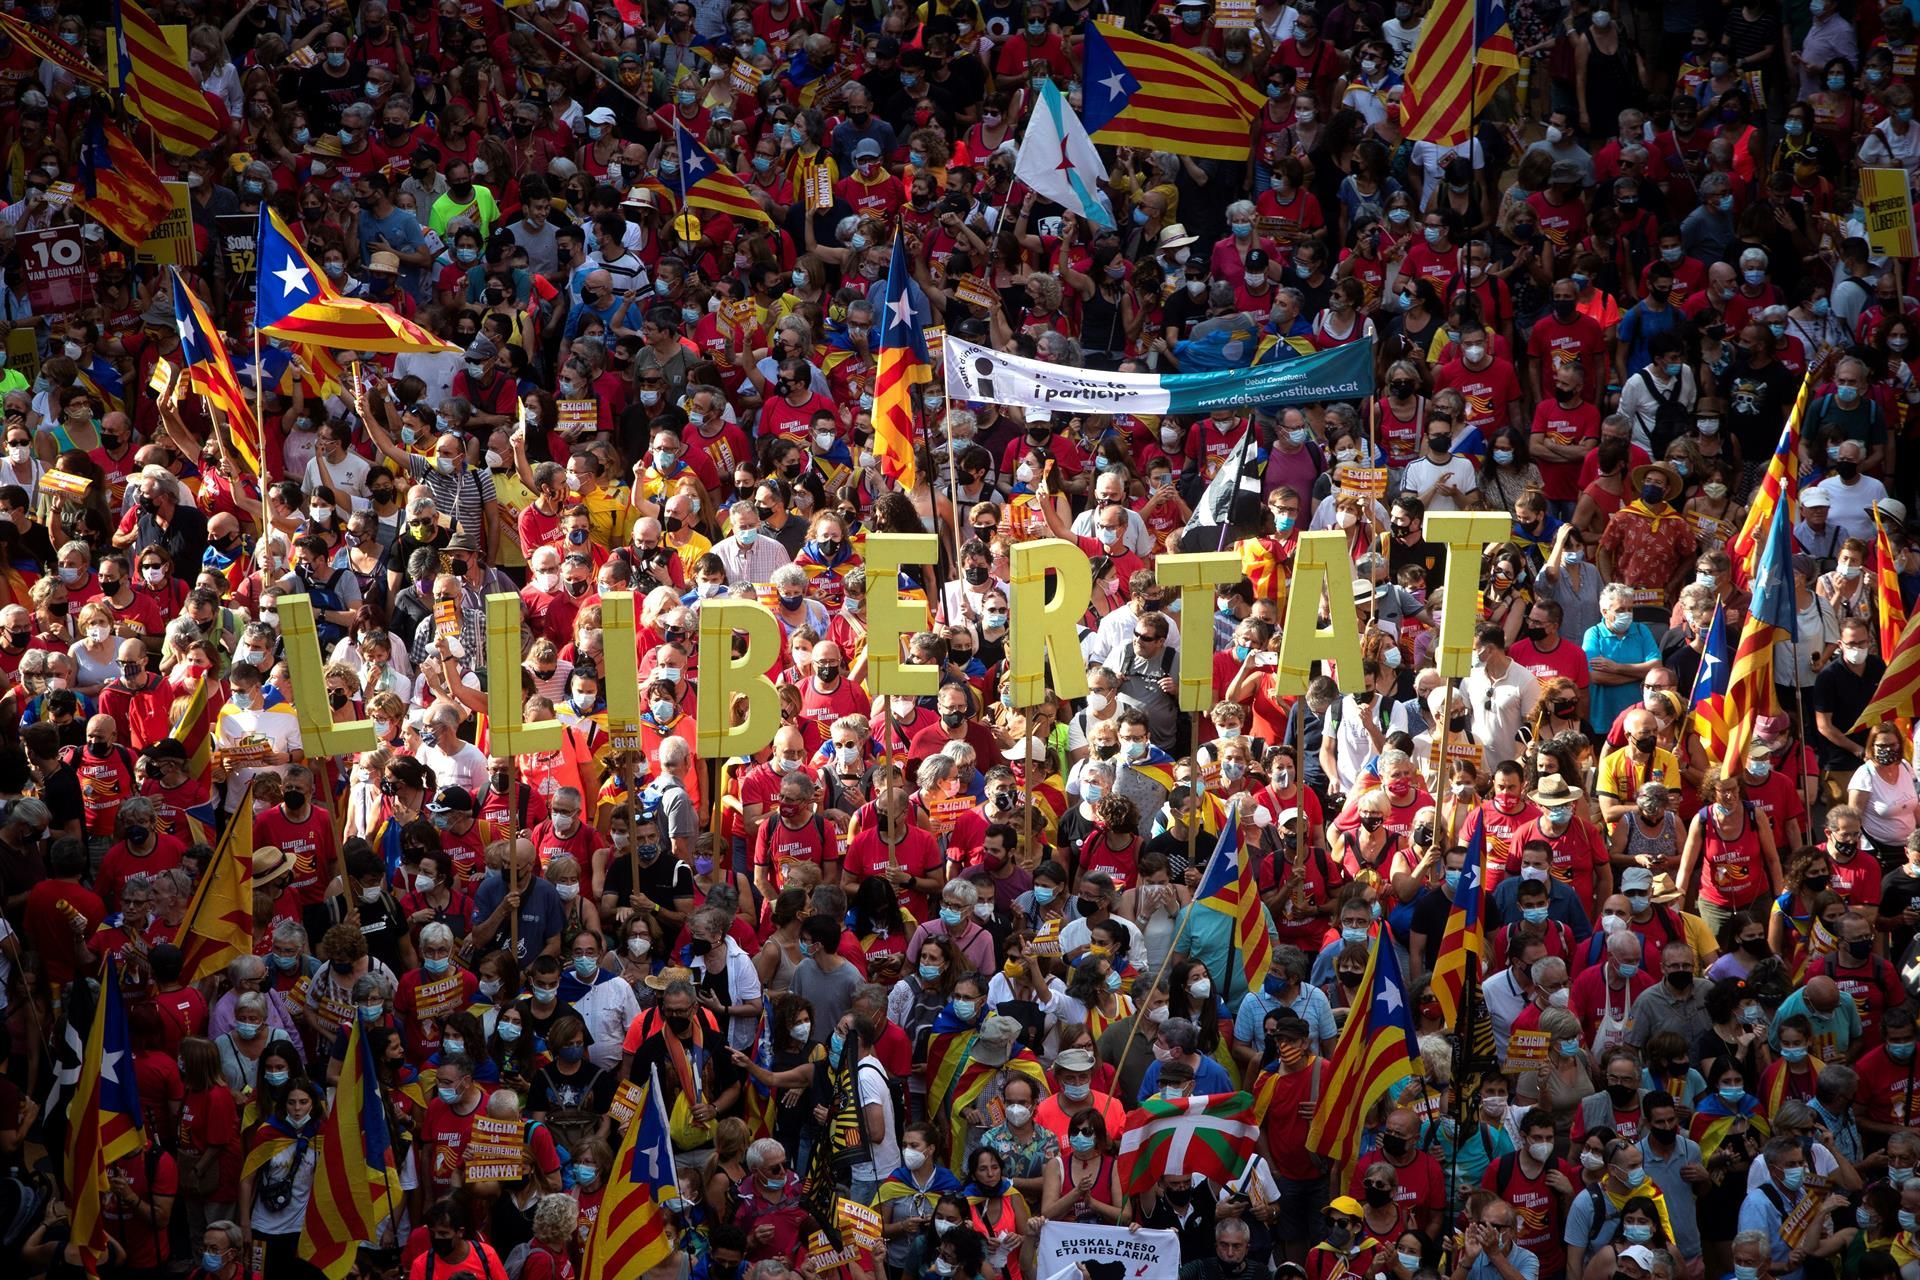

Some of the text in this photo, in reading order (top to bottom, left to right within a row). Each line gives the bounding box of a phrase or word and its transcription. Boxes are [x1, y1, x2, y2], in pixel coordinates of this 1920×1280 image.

[28, 271, 47, 281] VAM
[561, 402, 592, 411] EXIGIM
[937, 800, 971, 812] EXIGIM
[421, 980, 458, 997] EXIGIM
[438, 994, 446, 1003] LA
[1517, 1036, 1547, 1047] EXIGIM
[1525, 1049, 1533, 1057] LA
[477, 1119, 518, 1135] EXIGIM
[490, 1134, 500, 1143] LA
[469, 1164, 519, 1182] GUANYAT
[1513, 1192, 1535, 1203] LLUITEM
[845, 1203, 879, 1226] EXIGIM
[1784, 1198, 1814, 1234] EXIGIM
[856, 1219, 866, 1230] LA
[1062, 1238, 1156, 1253] EUSKAL PRESO
[1056, 1247, 1160, 1263] ETA IHESLARIAK
